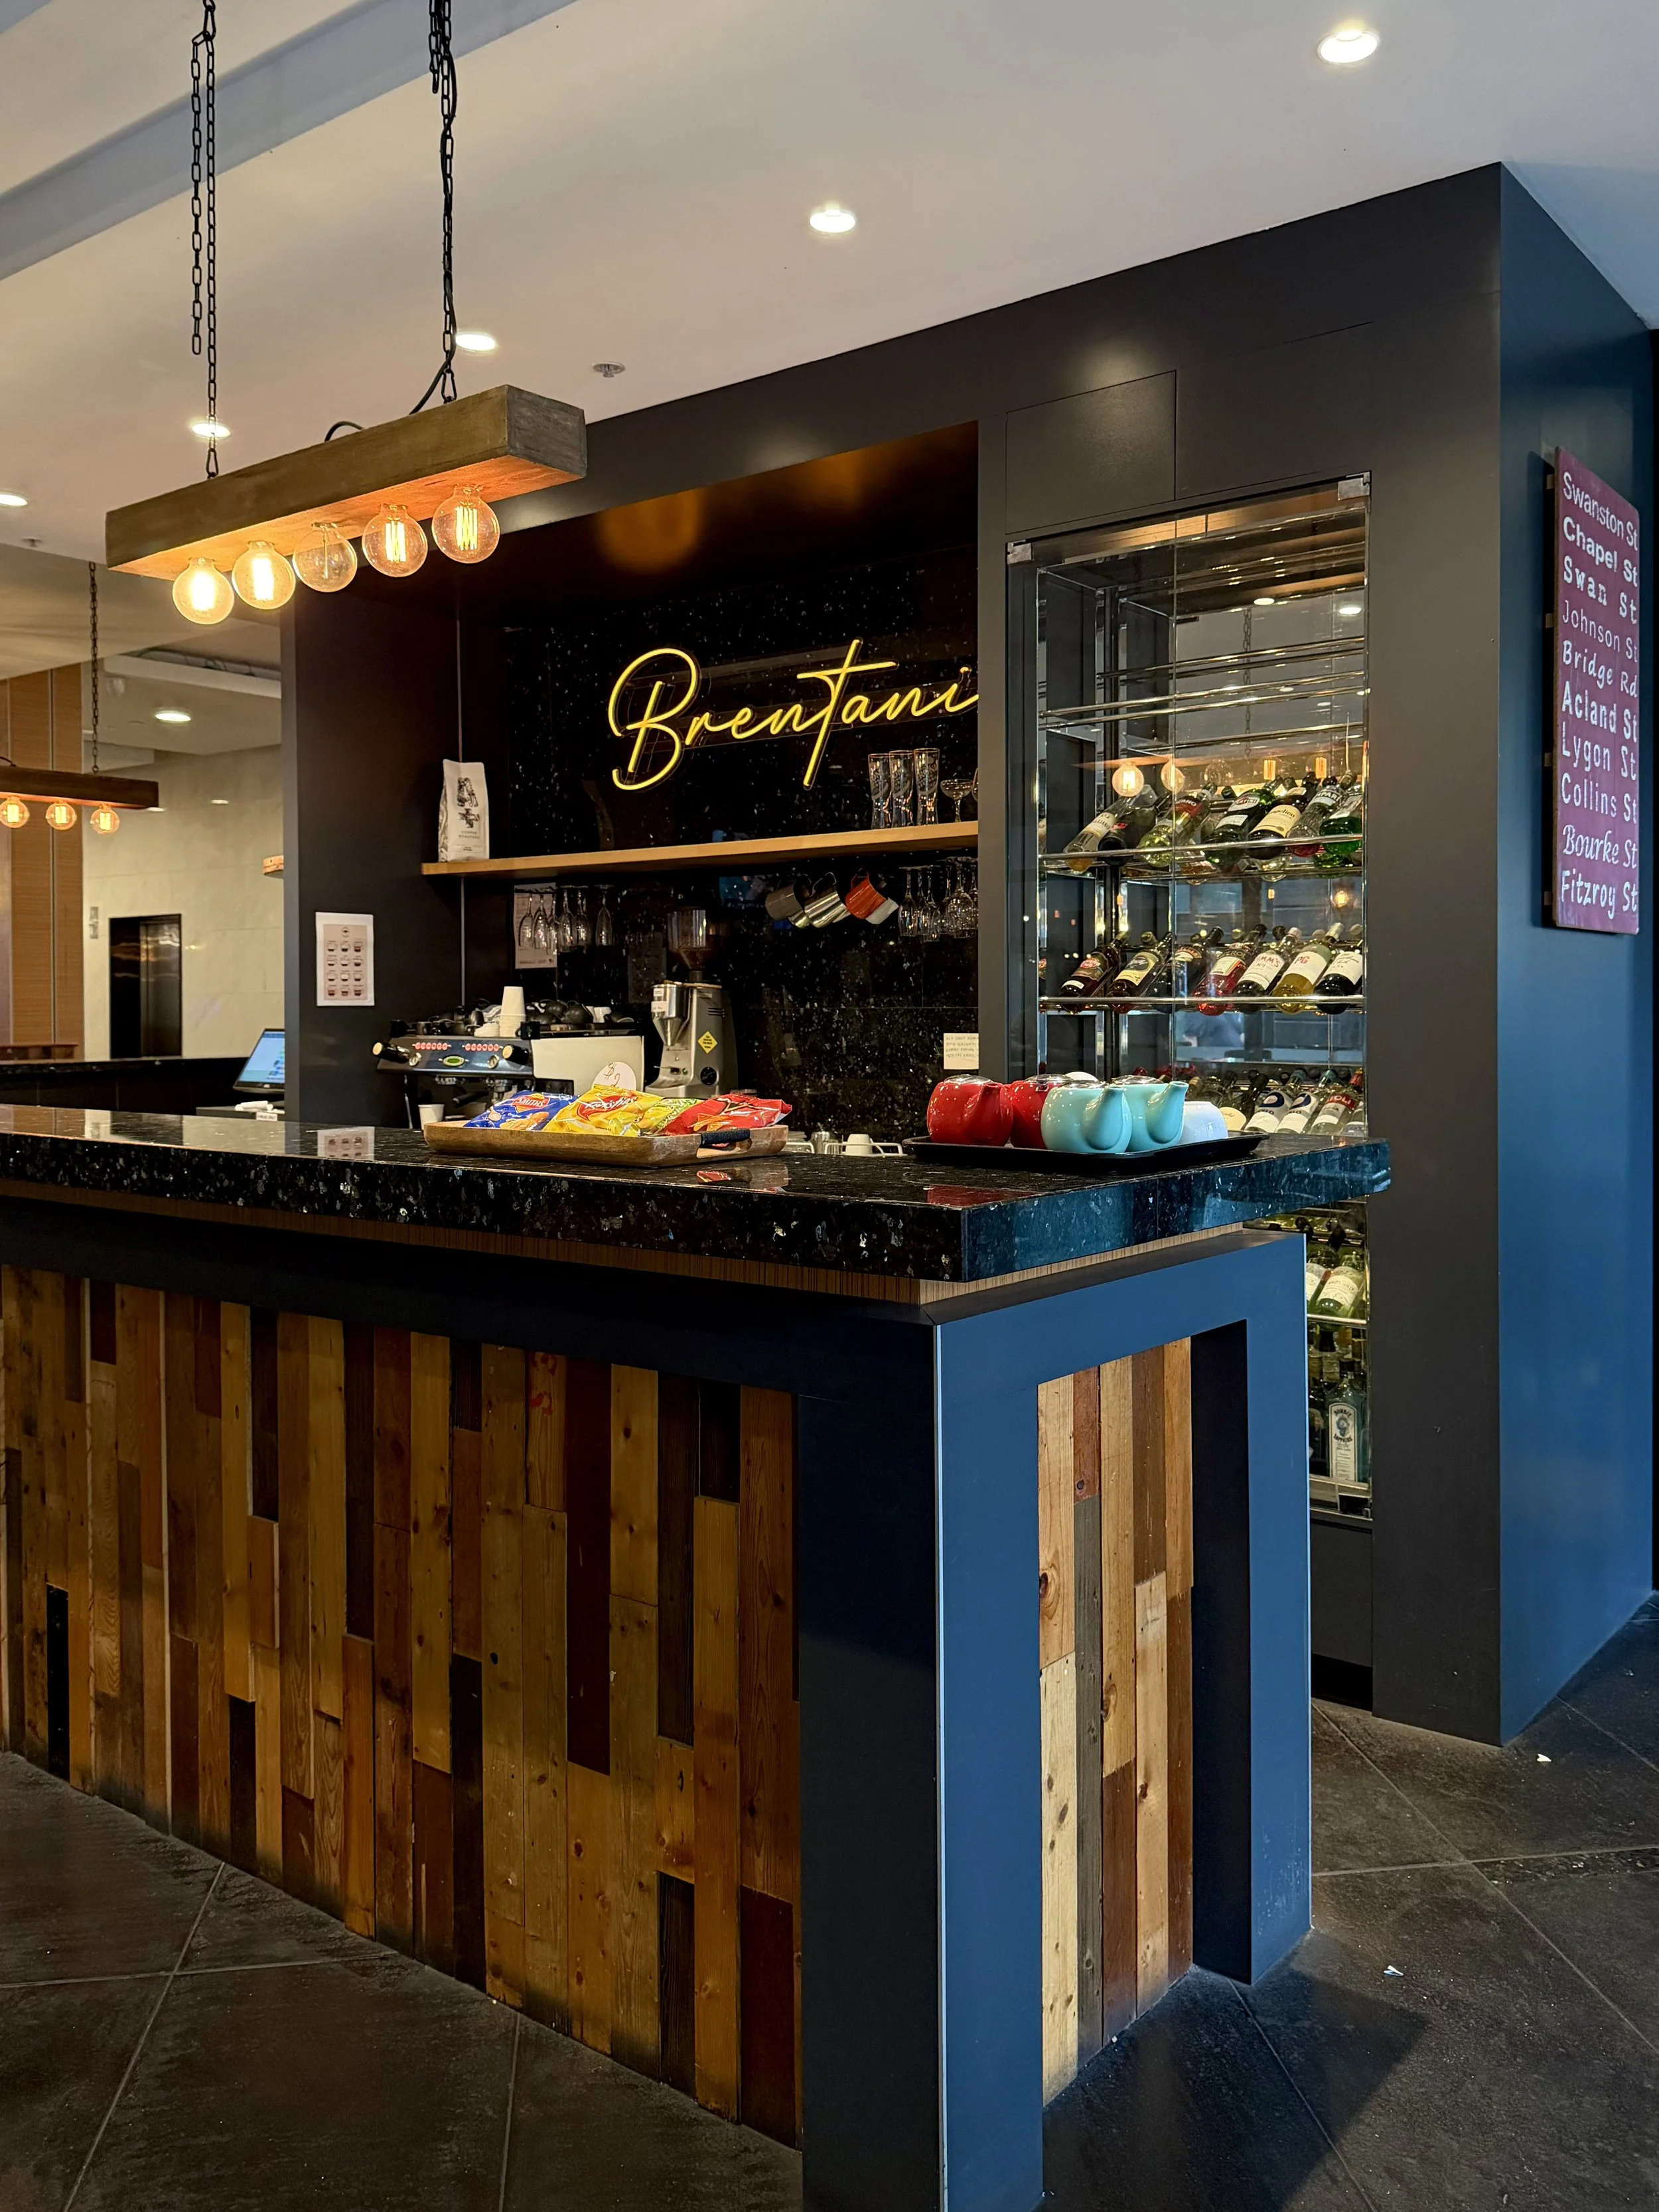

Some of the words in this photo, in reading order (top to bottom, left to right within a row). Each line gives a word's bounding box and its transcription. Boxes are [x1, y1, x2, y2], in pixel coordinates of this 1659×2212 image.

[1563, 472, 1624, 539] Swanston
[1626, 521, 1638, 551] St
[1563, 516, 1617, 573] Chapel
[1623, 559, 1638, 587] St
[1563, 555, 1607, 606] Swan
[1619, 592, 1637, 624] St
[1563, 599, 1620, 652] Johnson
[1626, 637, 1638, 663] St
[1563, 640, 1613, 689] Bridge
[1621, 671, 1638, 698] Rd
[1562, 681, 1617, 733] Acland
[1623, 709, 1637, 743] St
[1562, 721, 1611, 772] Lygon
[1621, 745, 1636, 781] St
[1561, 772, 1617, 818] Collins
[1623, 793, 1637, 824] St
[1562, 824, 1619, 864] Bourke
[1623, 839, 1638, 869] St
[1561, 868, 1616, 920] Fitzroy
[1623, 881, 1638, 912] St
